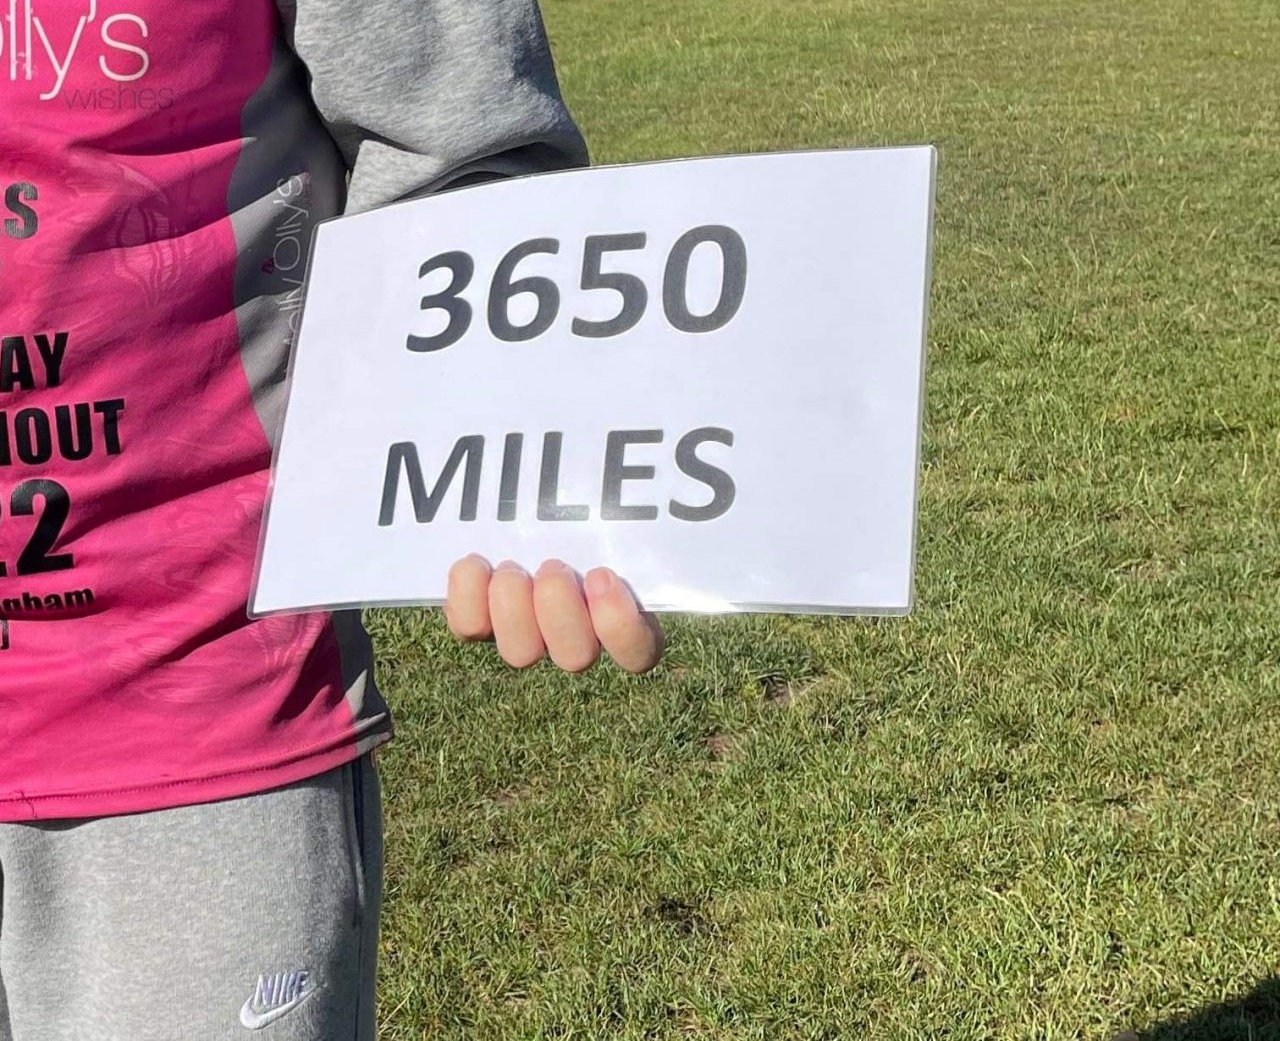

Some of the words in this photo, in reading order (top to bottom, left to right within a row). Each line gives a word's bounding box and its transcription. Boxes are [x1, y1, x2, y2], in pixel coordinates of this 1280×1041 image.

[63, 82, 174, 110] wishes
[406, 224, 748, 353] 3650
[378, 426, 737, 527] MILES
[253, 969, 311, 1006] NIKE
